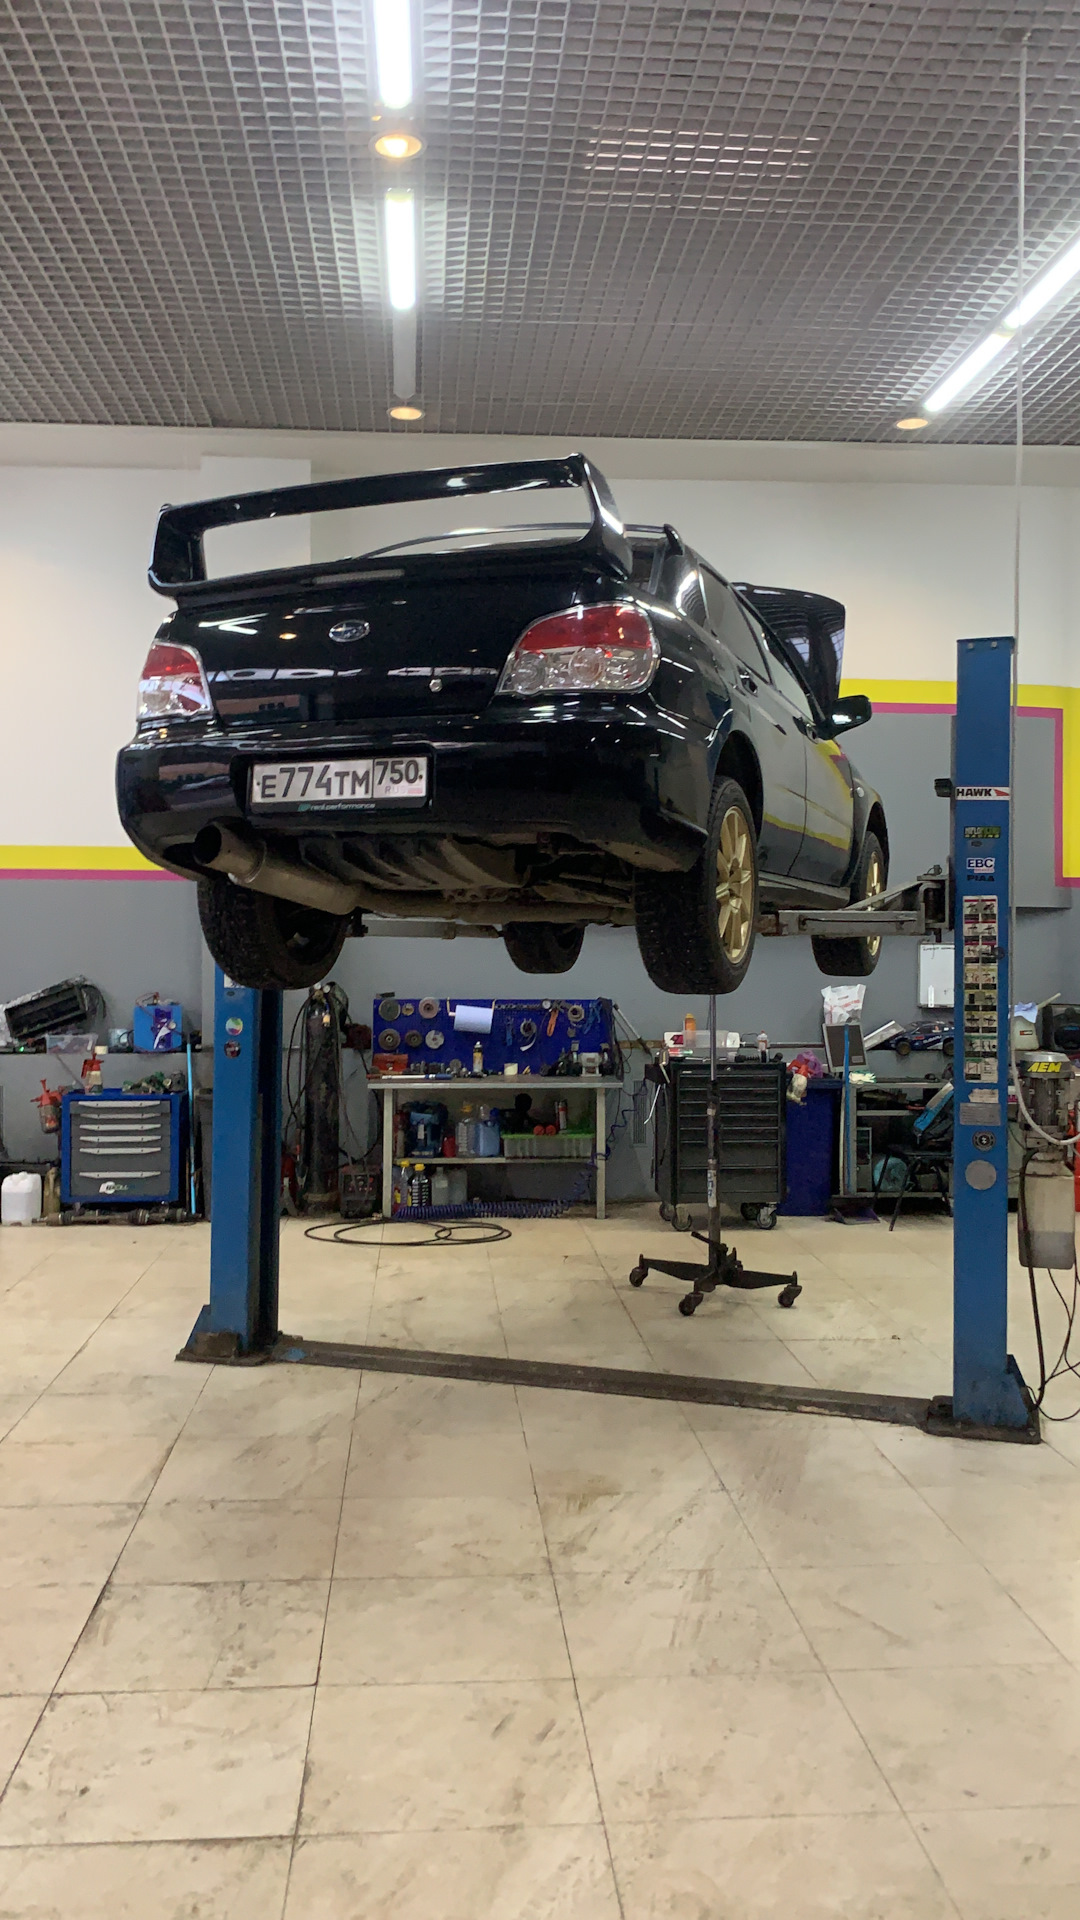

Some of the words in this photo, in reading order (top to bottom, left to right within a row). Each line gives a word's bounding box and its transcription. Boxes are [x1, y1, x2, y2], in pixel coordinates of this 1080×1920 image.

[380, 759, 419, 785] 750
[385, 786, 407, 794] RUS
[956, 788, 992, 797] HAWK
[967, 858, 994, 868] EBC
[966, 874, 996, 882] PIAA
[1027, 1061, 1062, 1073] AEM
